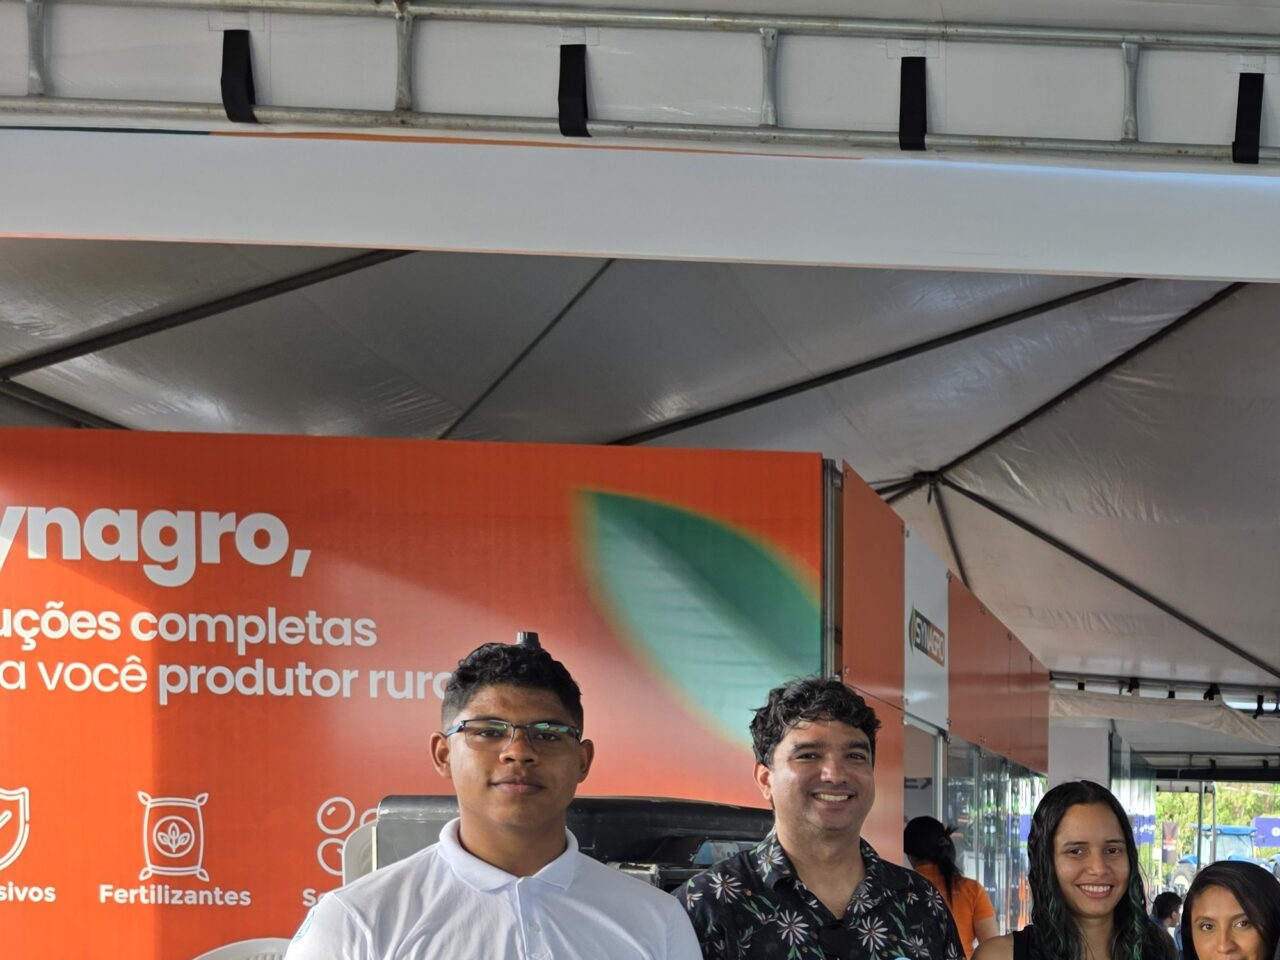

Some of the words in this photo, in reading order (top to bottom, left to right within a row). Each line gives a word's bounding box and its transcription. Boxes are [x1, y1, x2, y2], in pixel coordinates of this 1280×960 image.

[130, 607, 377, 656] completas
[38, 655, 148, 692] você
[159, 658, 359, 706] produtor
[99, 884, 251, 906] Fertilizantes
